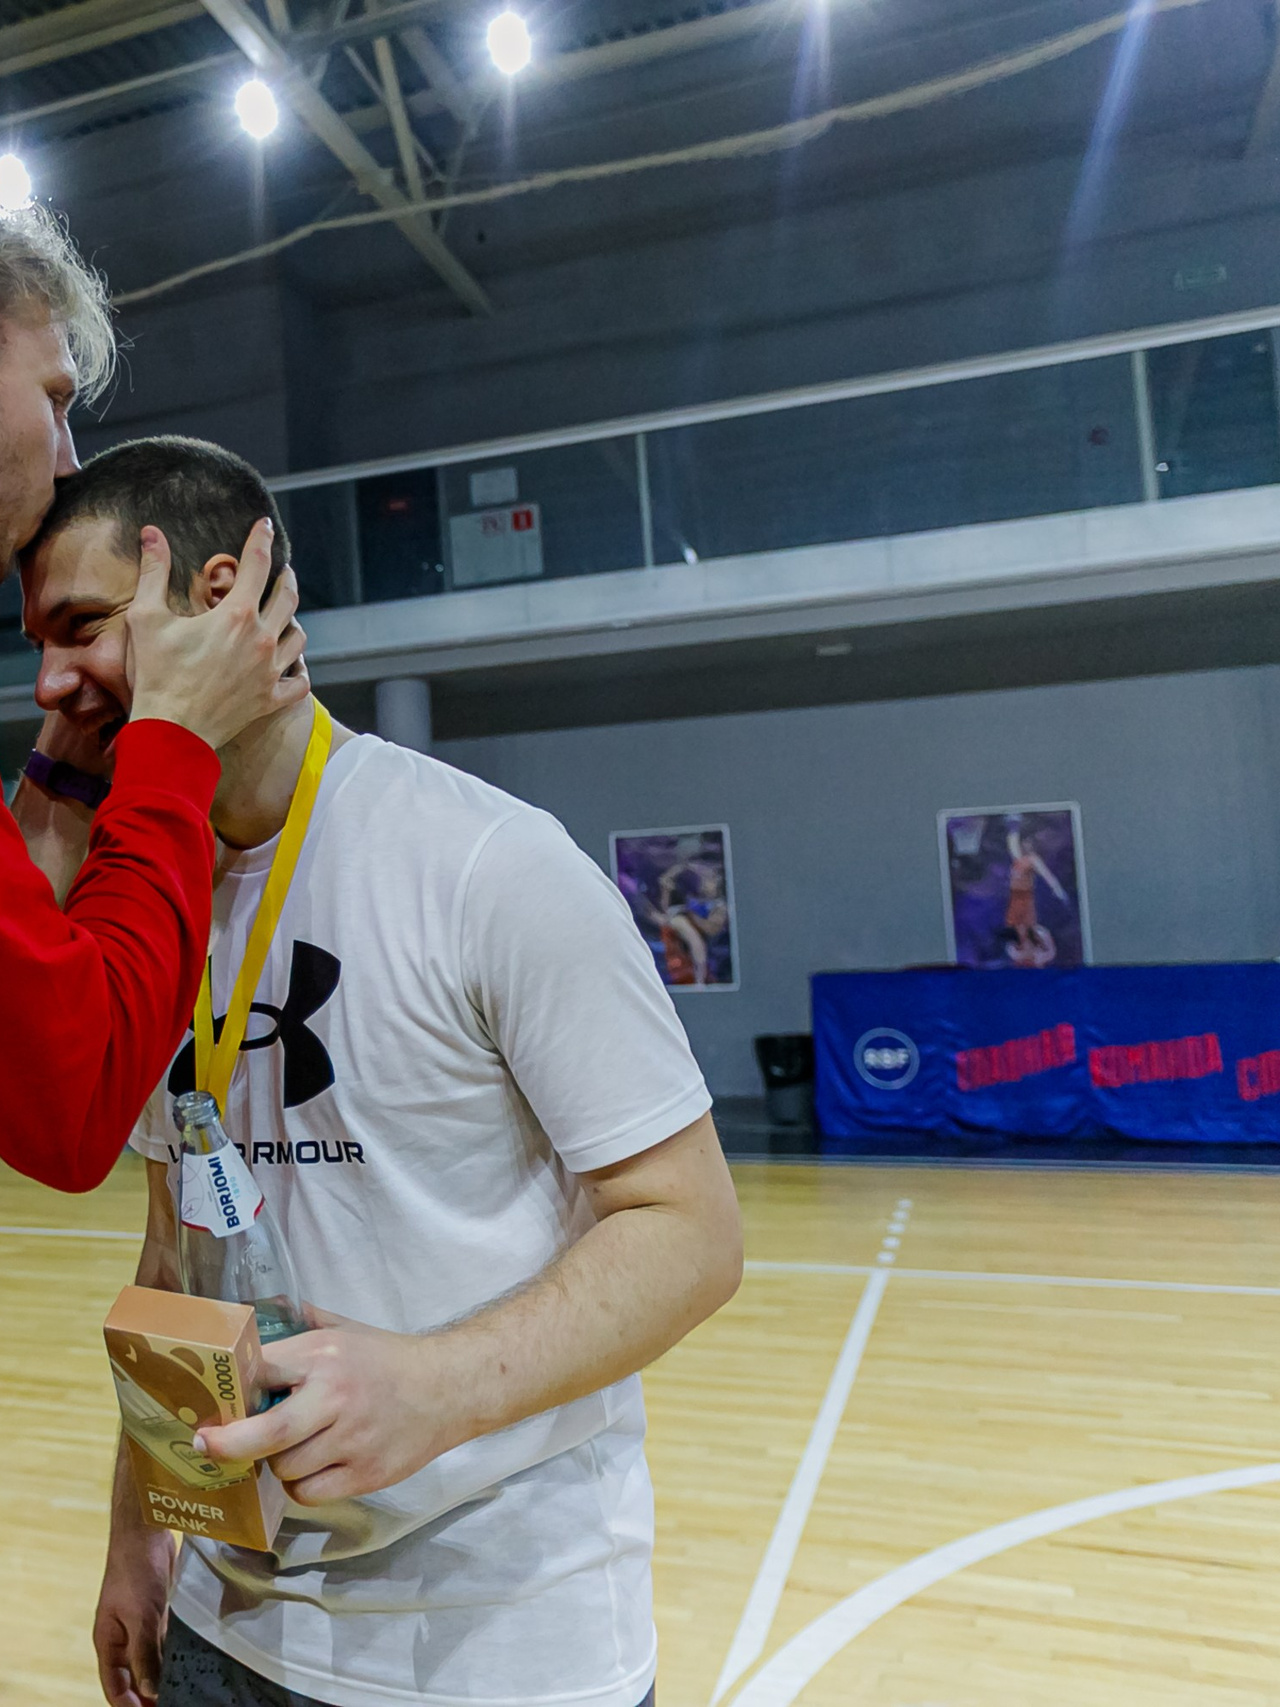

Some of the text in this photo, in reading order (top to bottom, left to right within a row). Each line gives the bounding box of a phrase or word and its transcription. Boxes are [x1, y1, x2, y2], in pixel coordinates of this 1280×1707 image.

[207, 1156, 241, 1229] BORJOMI
[212, 1352, 236, 1401] 30000
[148, 1491, 225, 1521] POWER
[152, 1508, 210, 1534] BANK
